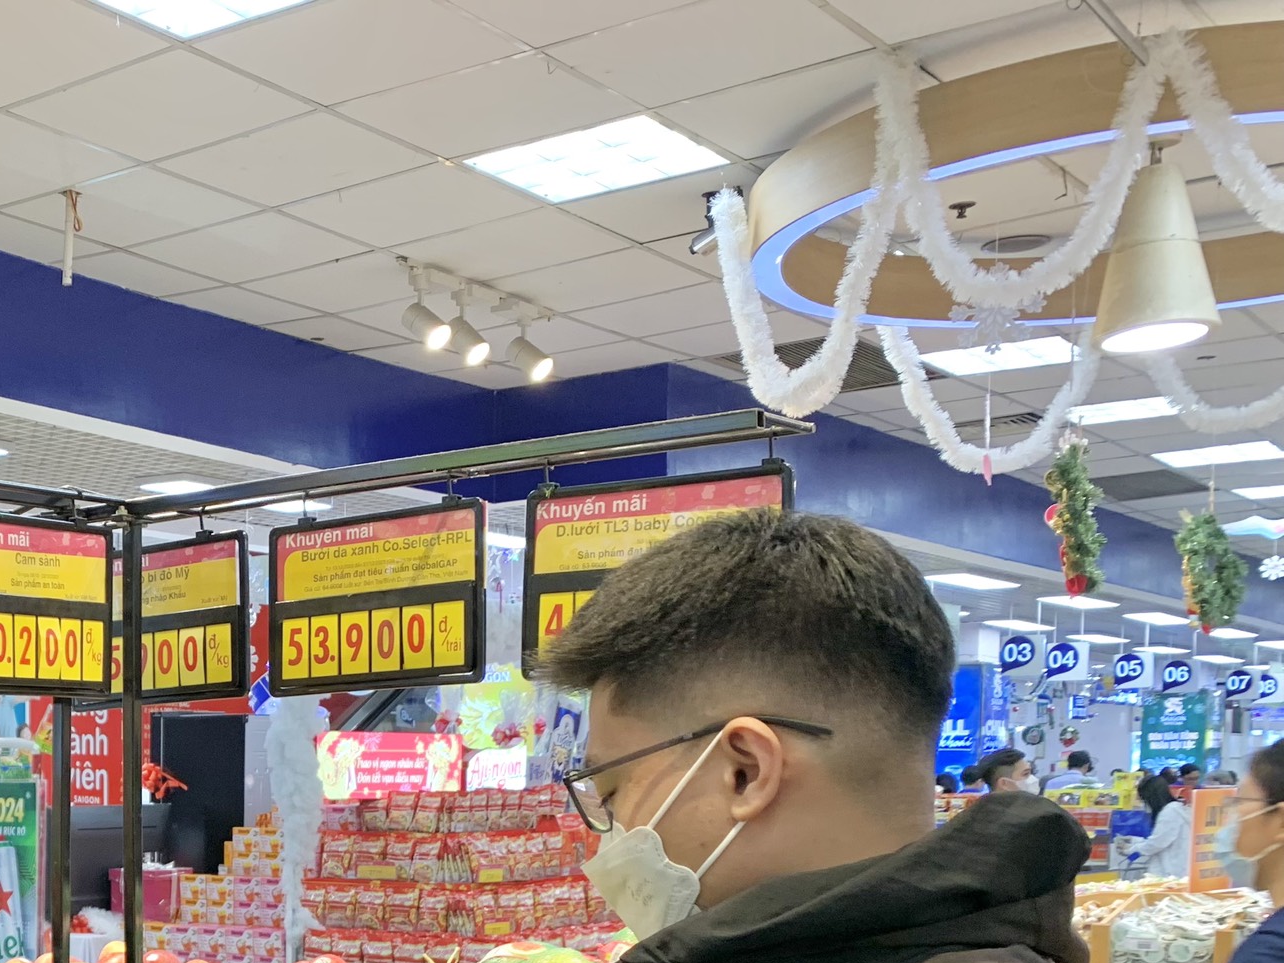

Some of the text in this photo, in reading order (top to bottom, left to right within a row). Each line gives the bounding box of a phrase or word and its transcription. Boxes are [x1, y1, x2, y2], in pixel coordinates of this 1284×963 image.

[612, 493, 647, 513] mãi
[604, 520, 629, 533] TL3
[634, 517, 670, 532] baby
[8, 531, 29, 546] mãi
[333, 547, 347, 558] da
[351, 543, 379, 557] xanh
[383, 530, 472, 553] Co.Select-RPL
[15, 553, 60, 567] Cam sành
[411, 559, 458, 571] GlobalGAP
[176, 567, 190, 579] Mỹ
[288, 613, 425, 666] 53.900
[1003, 643, 1032, 661] 03
[1048, 650, 1076, 668] 04
[1116, 660, 1142, 677] 05
[1164, 665, 1189, 683] 06
[1227, 675, 1251, 690] 07
